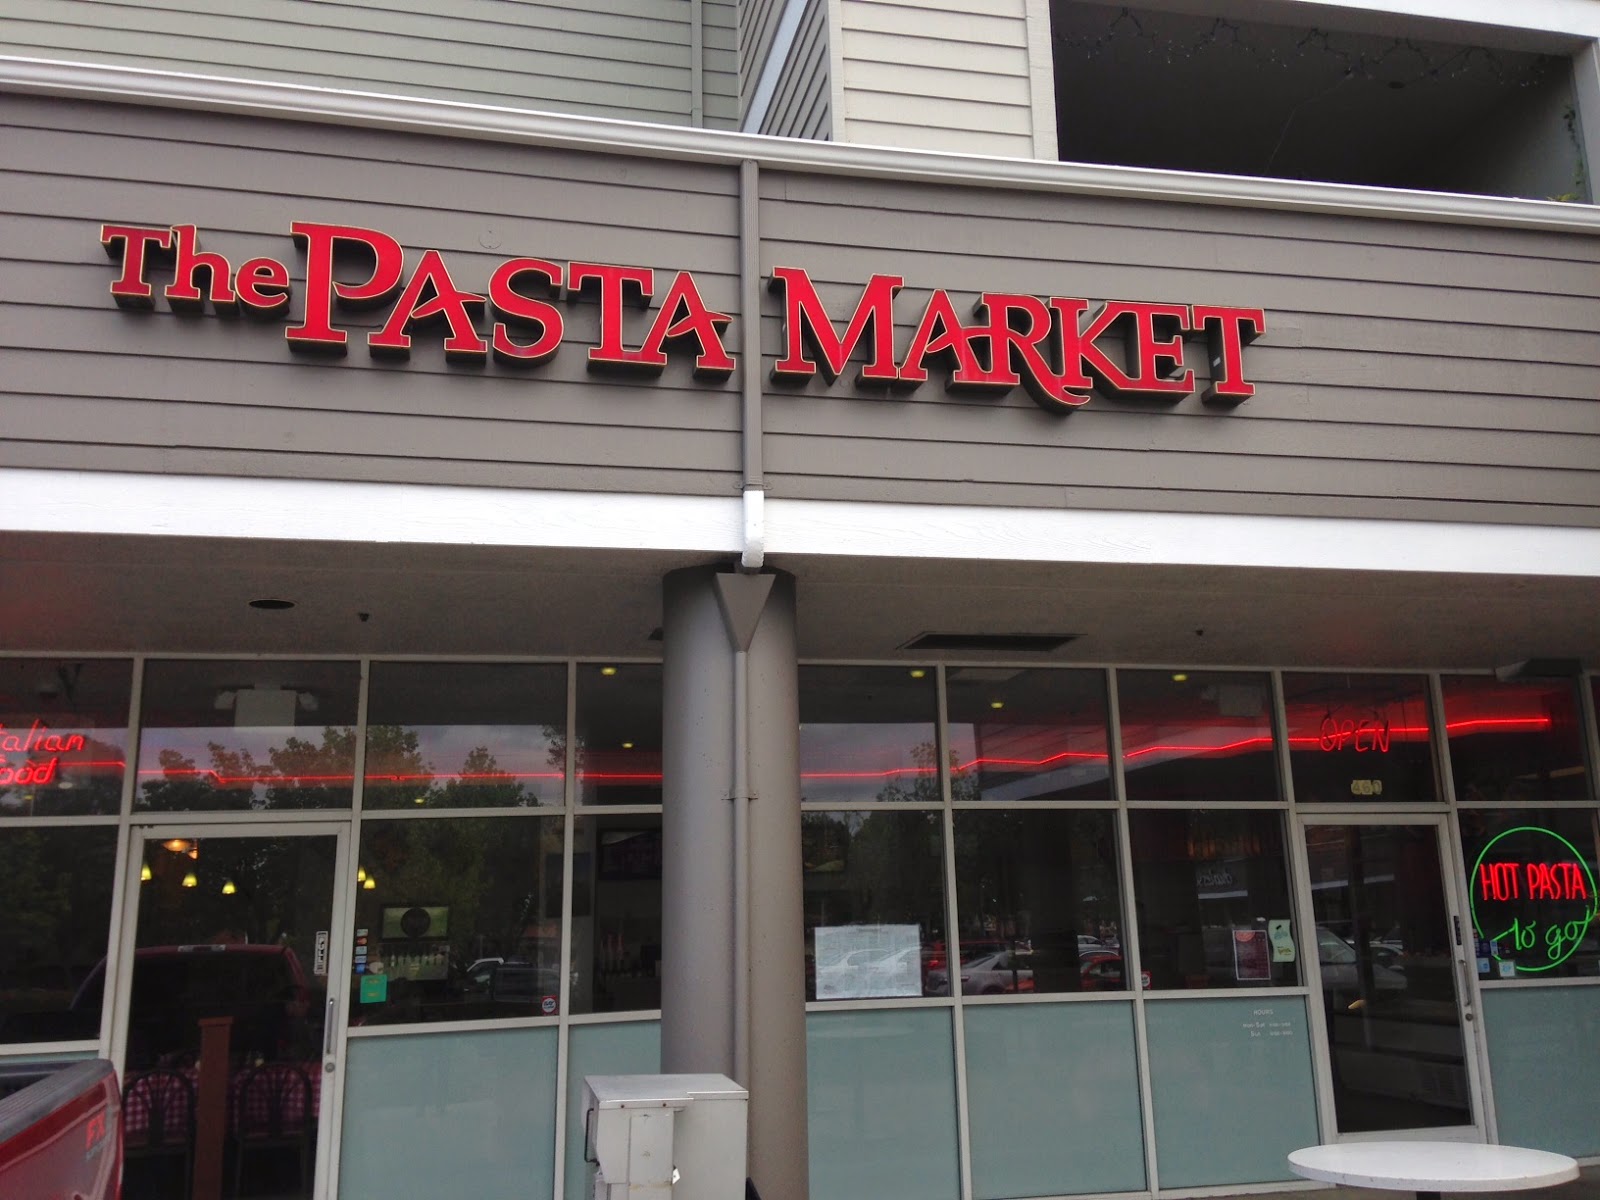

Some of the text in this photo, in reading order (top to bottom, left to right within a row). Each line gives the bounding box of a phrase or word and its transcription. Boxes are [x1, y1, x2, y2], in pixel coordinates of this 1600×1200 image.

[101, 220, 1265, 407] The PASTA MARKET
[1320, 718, 1391, 752] OPEN
[0, 755, 58, 785] ood
[1480, 863, 1588, 900] HOT PASTA
[1492, 917, 1537, 951] to
[1545, 920, 1583, 960] go
